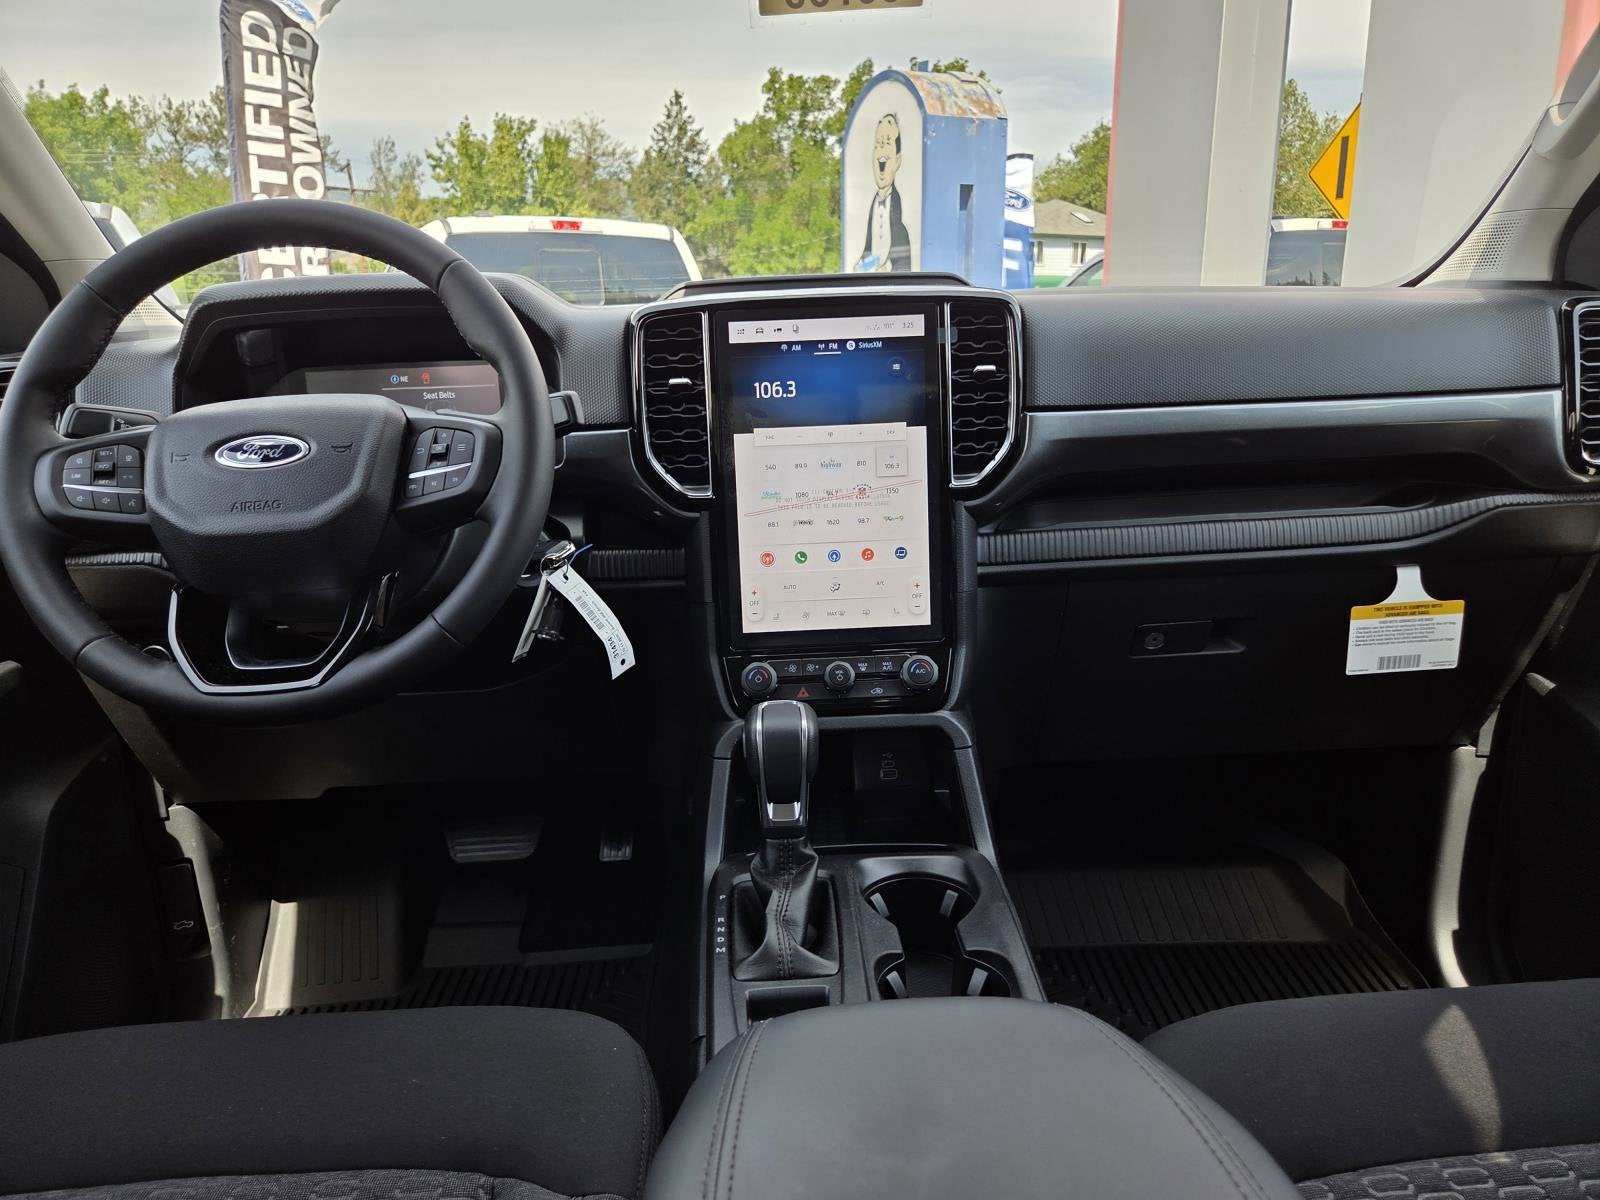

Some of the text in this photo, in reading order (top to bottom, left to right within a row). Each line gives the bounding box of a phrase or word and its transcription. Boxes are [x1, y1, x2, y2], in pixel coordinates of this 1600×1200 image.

[858, 341, 882, 349] SiriusXM
[400, 375, 409, 383] NE
[753, 380, 796, 399] 106.3
[423, 391, 456, 400] Seat Belts
[238, 444, 283, 459] Ford
[231, 500, 283, 513] AIRBAG
